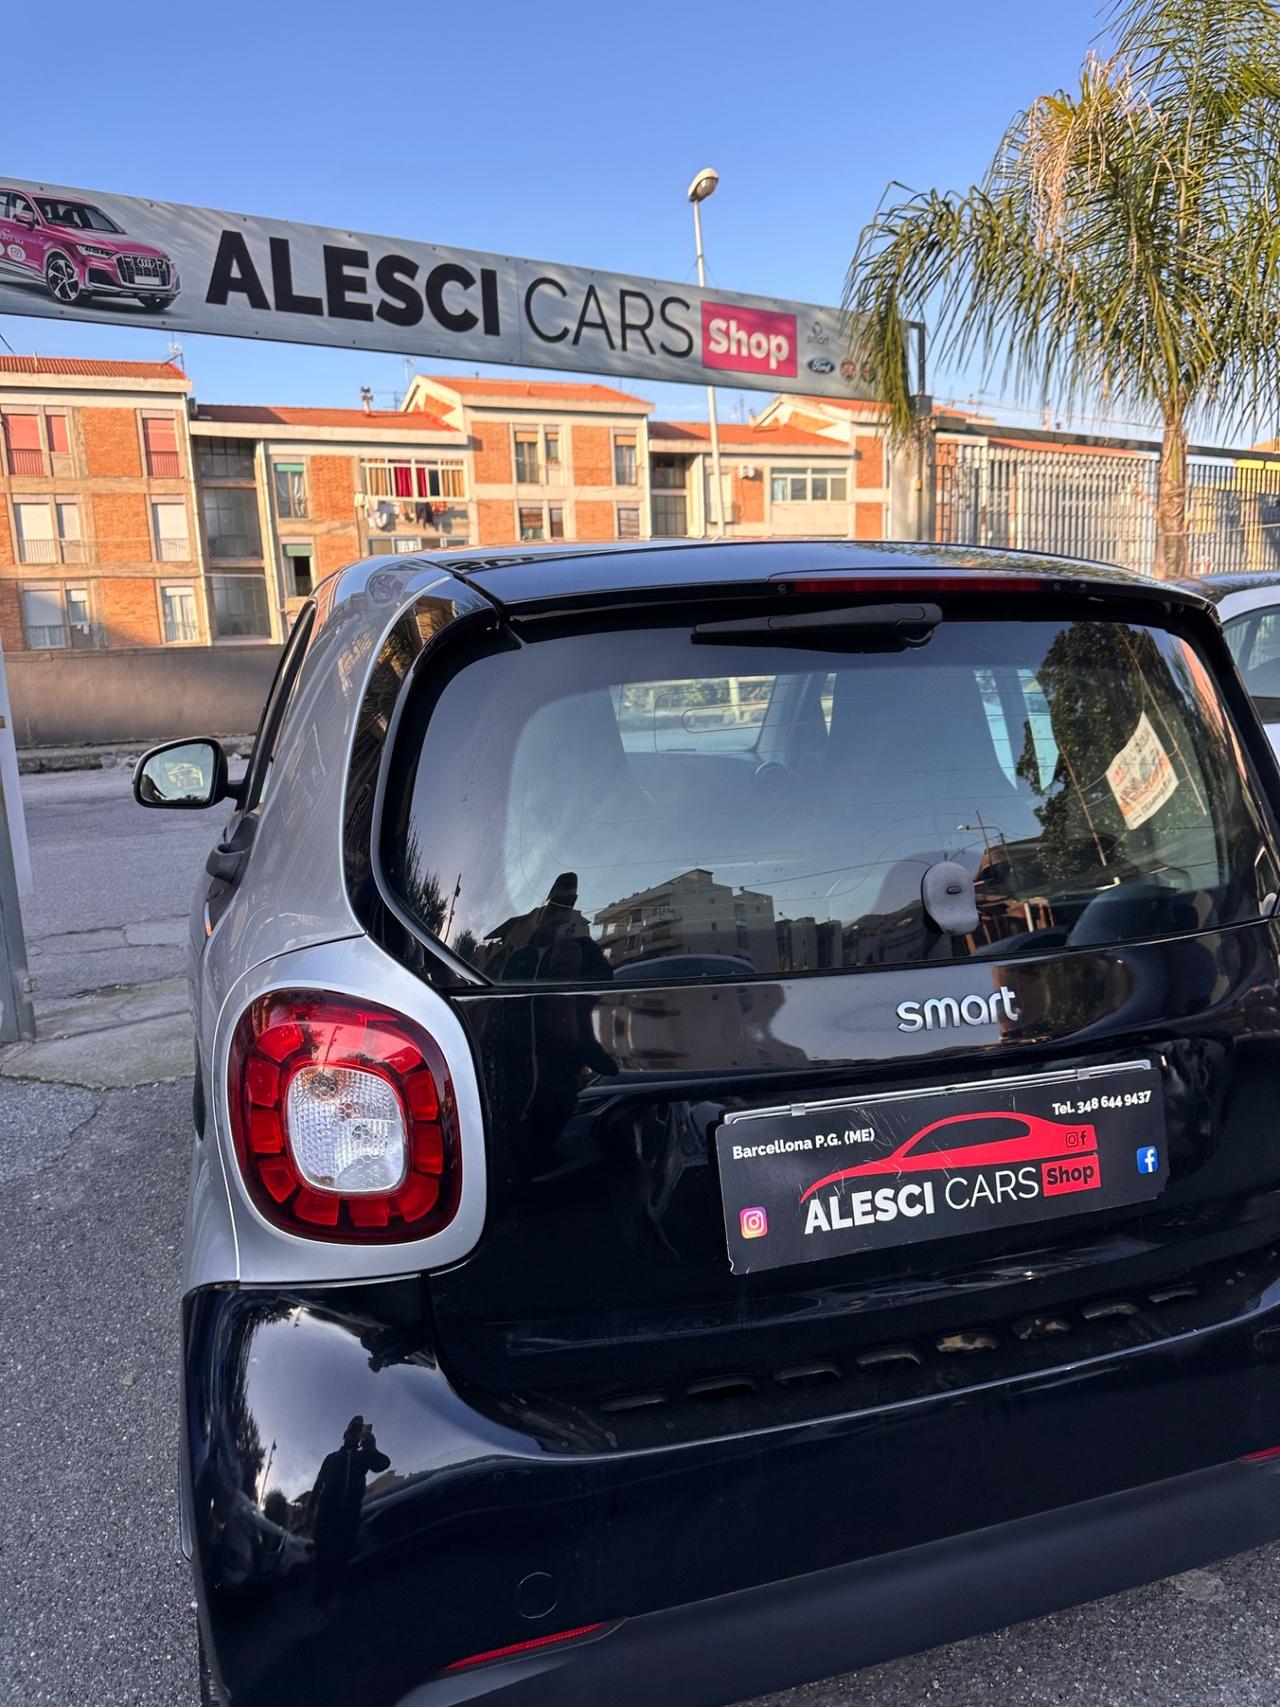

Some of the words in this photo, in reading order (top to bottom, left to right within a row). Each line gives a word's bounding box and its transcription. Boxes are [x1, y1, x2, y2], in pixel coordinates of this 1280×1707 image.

[205, 229, 500, 336] ALESCI
[524, 276, 694, 358] CARS
[708, 318, 790, 369] Shop
[896, 985, 1019, 1033] smart
[1052, 1103, 1075, 1115] Tel.
[1077, 1098, 1099, 1113] 348
[1101, 1095, 1122, 1108] 644
[1124, 1090, 1152, 1106] 9437
[732, 1138, 813, 1160] Barcellona
[815, 1133, 842, 1149] P.G.
[844, 1127, 875, 1145] (ME)
[804, 1181, 935, 1235] ALESCI
[945, 1166, 1040, 1210] CARS
[1046, 1163, 1095, 1185] Shop
